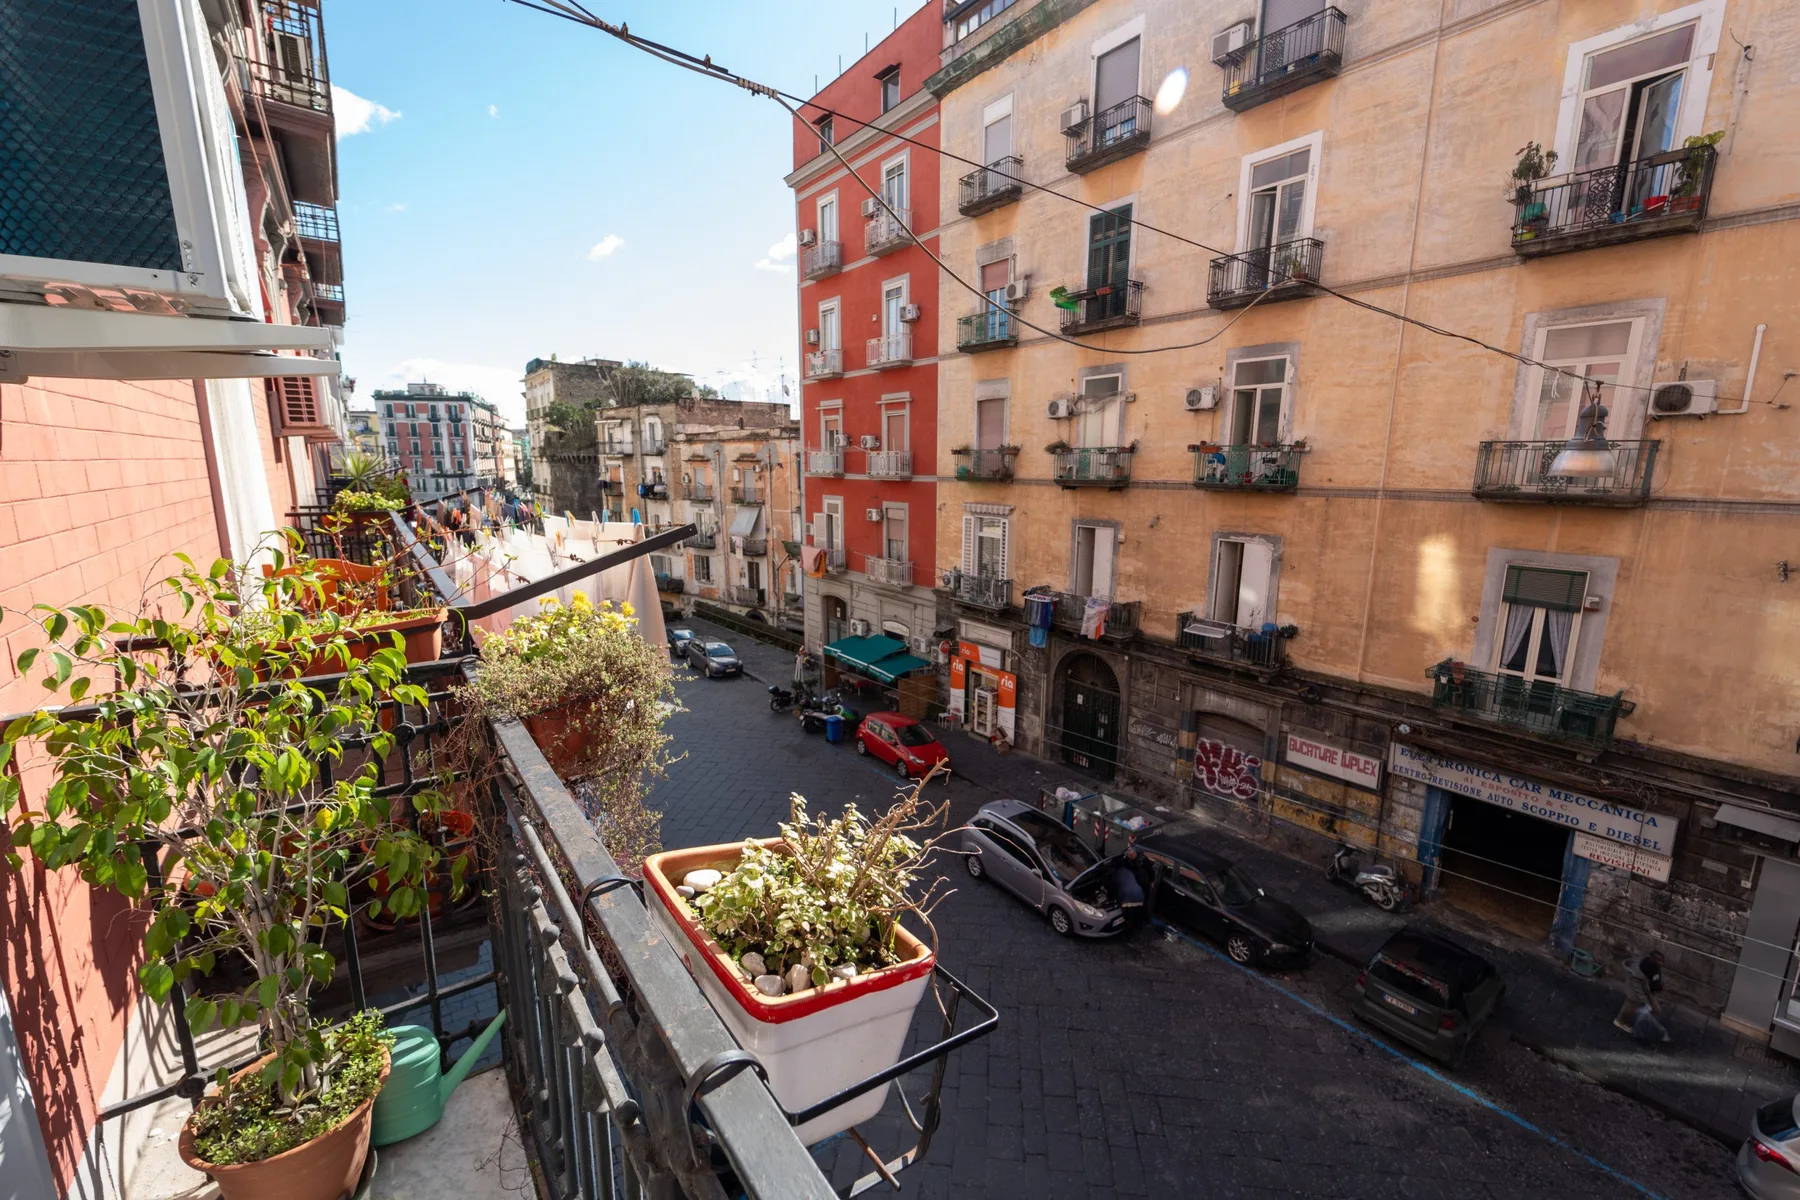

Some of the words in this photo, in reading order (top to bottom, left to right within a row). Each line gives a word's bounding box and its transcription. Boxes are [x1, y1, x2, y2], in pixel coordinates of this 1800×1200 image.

[952, 659, 964, 671] ria
[1001, 676, 1013, 688] ria
[1463, 776, 1473, 784] di
[1480, 781, 1539, 802] ESPOSITO
[1545, 800, 1554, 808] &
[1560, 804, 1572, 812] C.
[1509, 777, 1542, 794] CAR
[1549, 789, 1658, 828] MECCANICA
[1393, 764, 1427, 780] CENTRO
[1431, 777, 1482, 797] REVISIONE
[1487, 793, 1513, 806] AUTO
[1521, 802, 1580, 826] SCOPPIO
[1588, 821, 1598, 831] E
[1606, 827, 1661, 851] DIESEL
[1581, 844, 1598, 853] TESTER
[1585, 841, 1622, 854] MULTIMEDIALE
[1624, 851, 1659, 865] INTRATTIVA
[1589, 852, 1651, 876] REVISIONI
